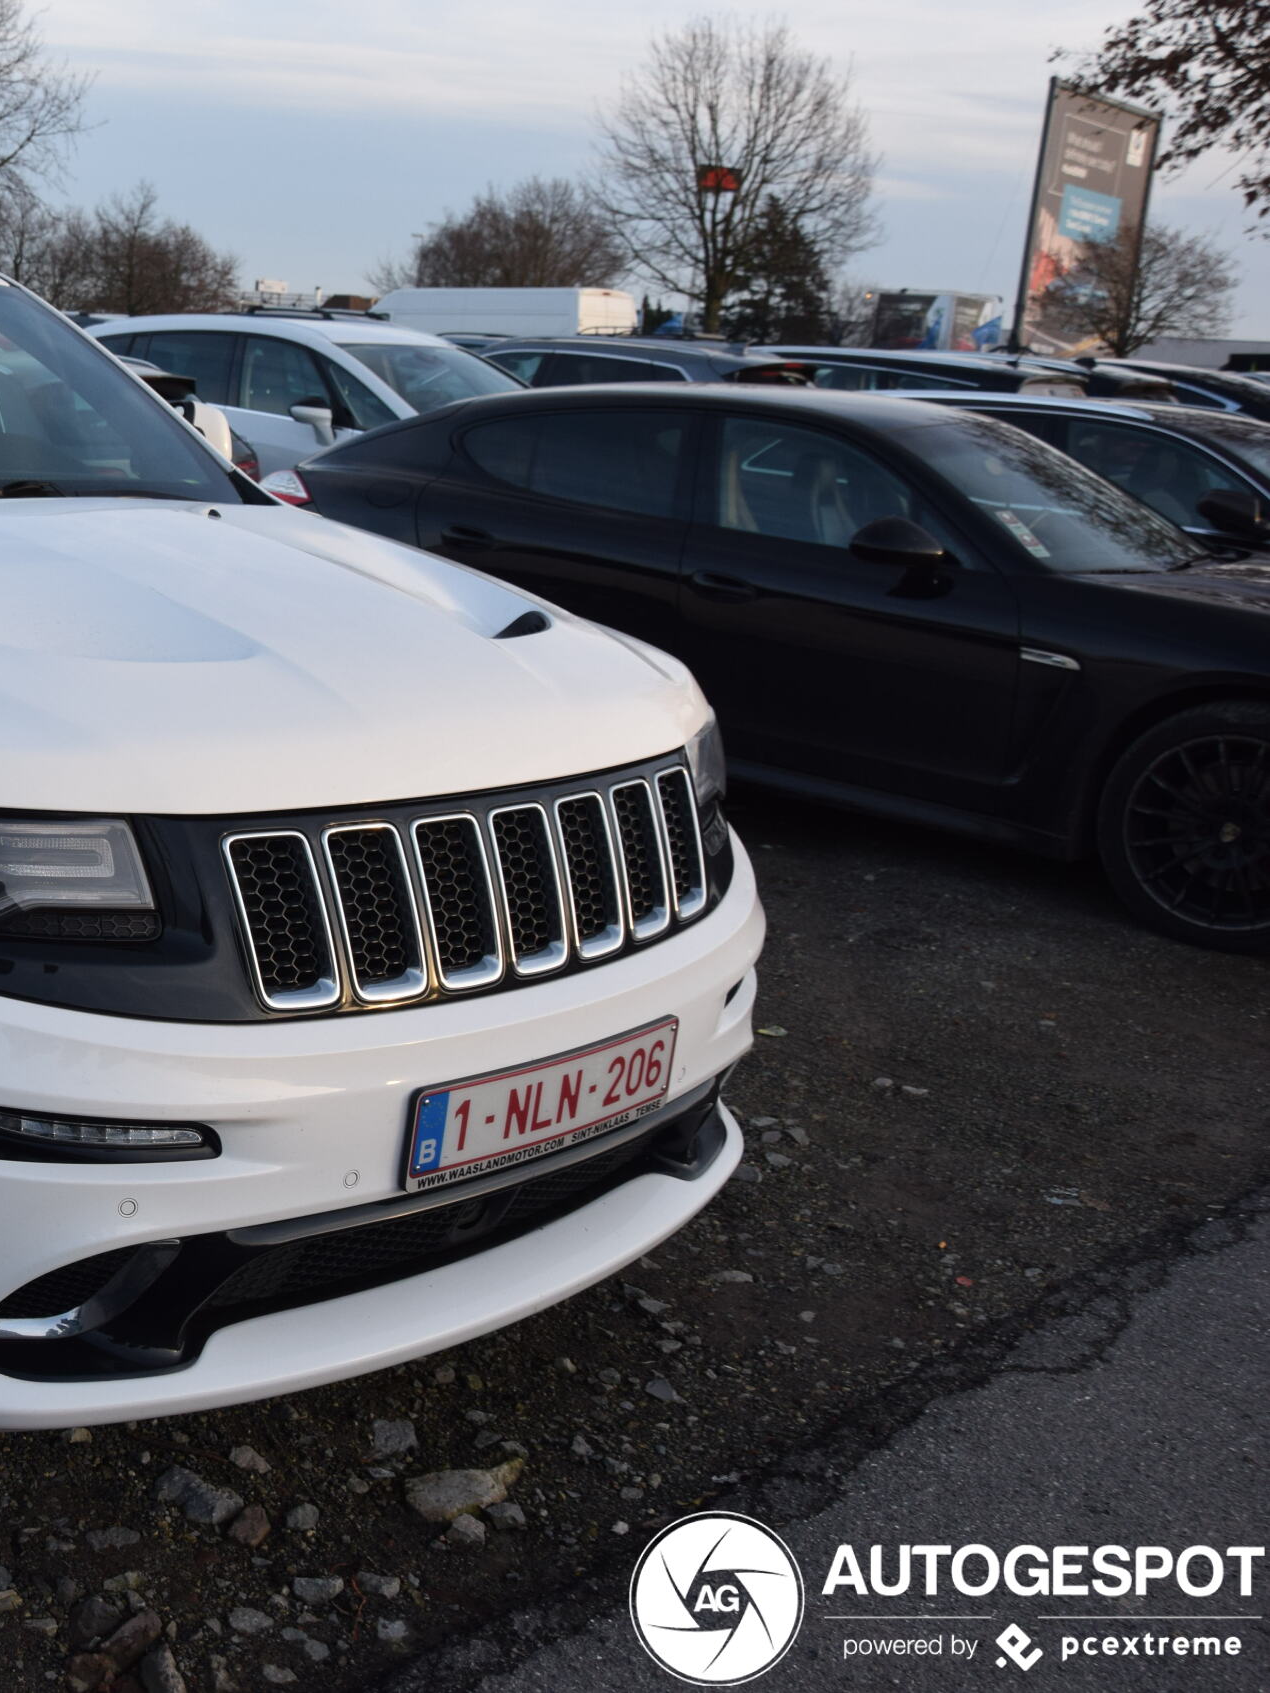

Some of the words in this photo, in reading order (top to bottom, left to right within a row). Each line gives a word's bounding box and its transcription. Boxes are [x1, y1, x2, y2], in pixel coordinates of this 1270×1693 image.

[454, 1040, 665, 1151] 1-NLN-206
[417, 1137, 565, 1190] WWW.WAASLANDMOTOR.COM
[571, 1111, 630, 1143] SINT-NIKLAAS
[635, 1099, 662, 1118] TEMSE
[418, 1138, 437, 1165] B
